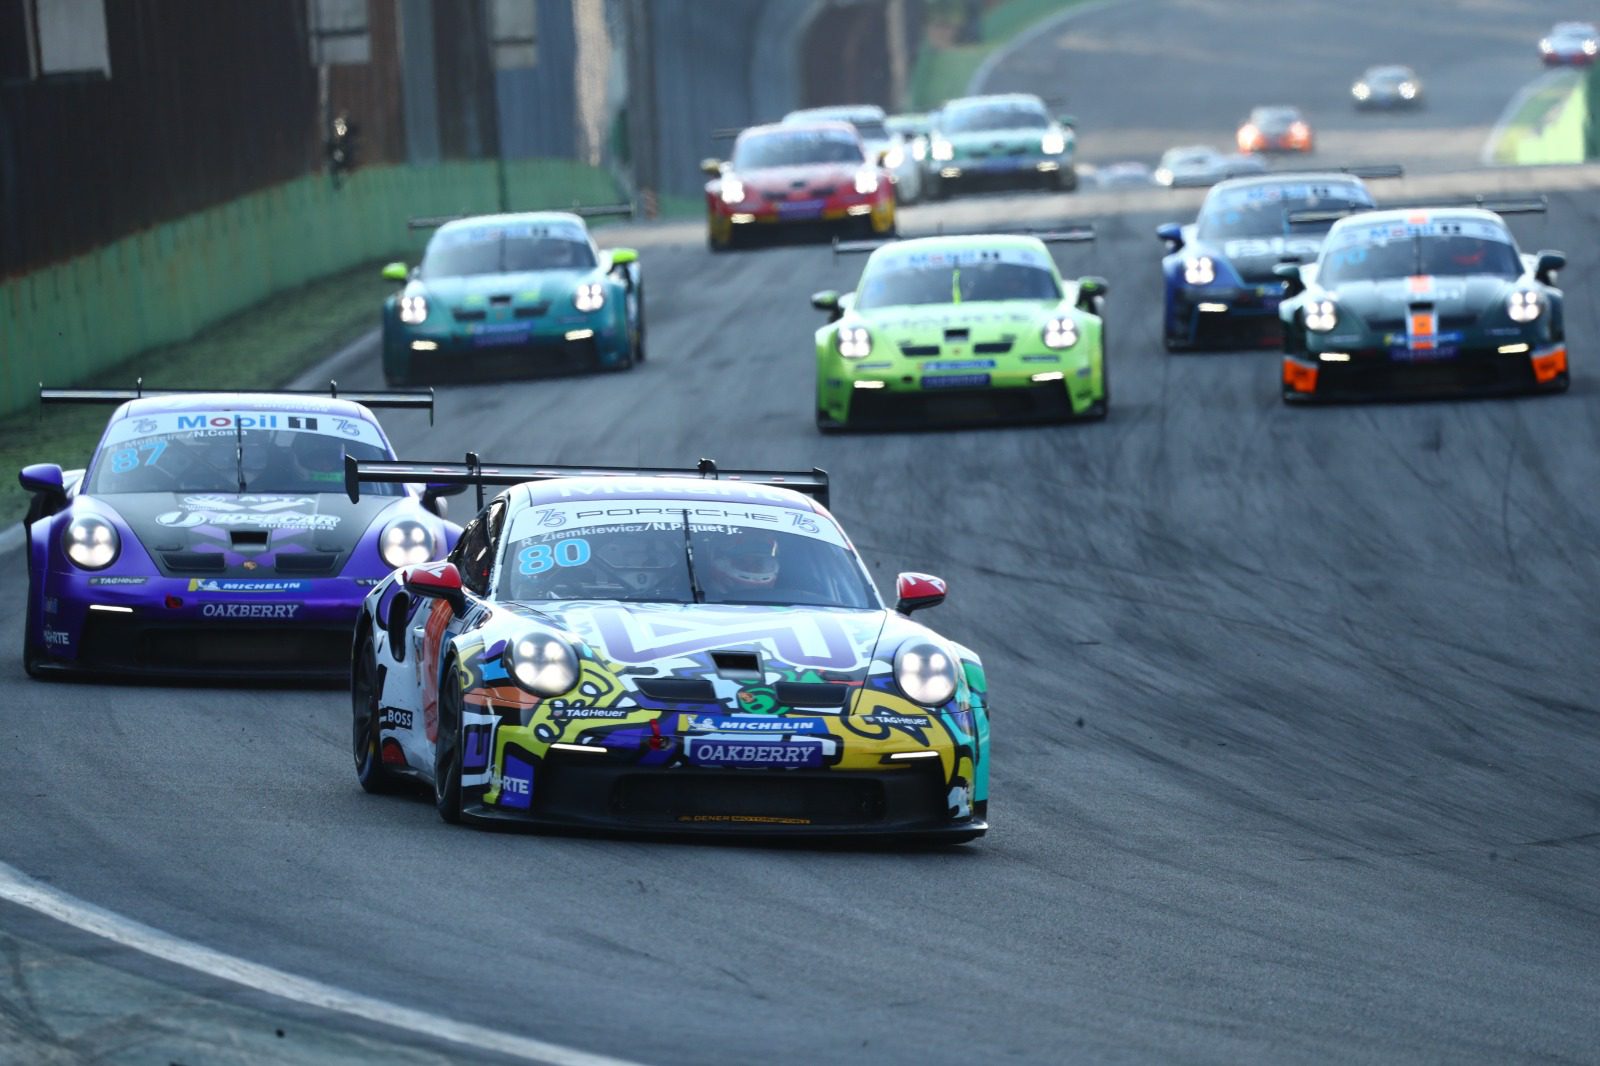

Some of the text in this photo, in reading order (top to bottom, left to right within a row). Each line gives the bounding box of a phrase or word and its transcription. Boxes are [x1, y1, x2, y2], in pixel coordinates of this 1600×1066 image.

[178, 415, 277, 429] Mobil
[111, 440, 169, 474] 87
[576, 508, 779, 523] PORSCHE
[518, 538, 591, 576] 80
[222, 582, 301, 590] MICHELIN
[202, 604, 299, 618] OAKBERRY
[387, 709, 412, 727] BOSS
[719, 721, 815, 730] MICHELIN
[697, 745, 816, 762] OAKBERRY
